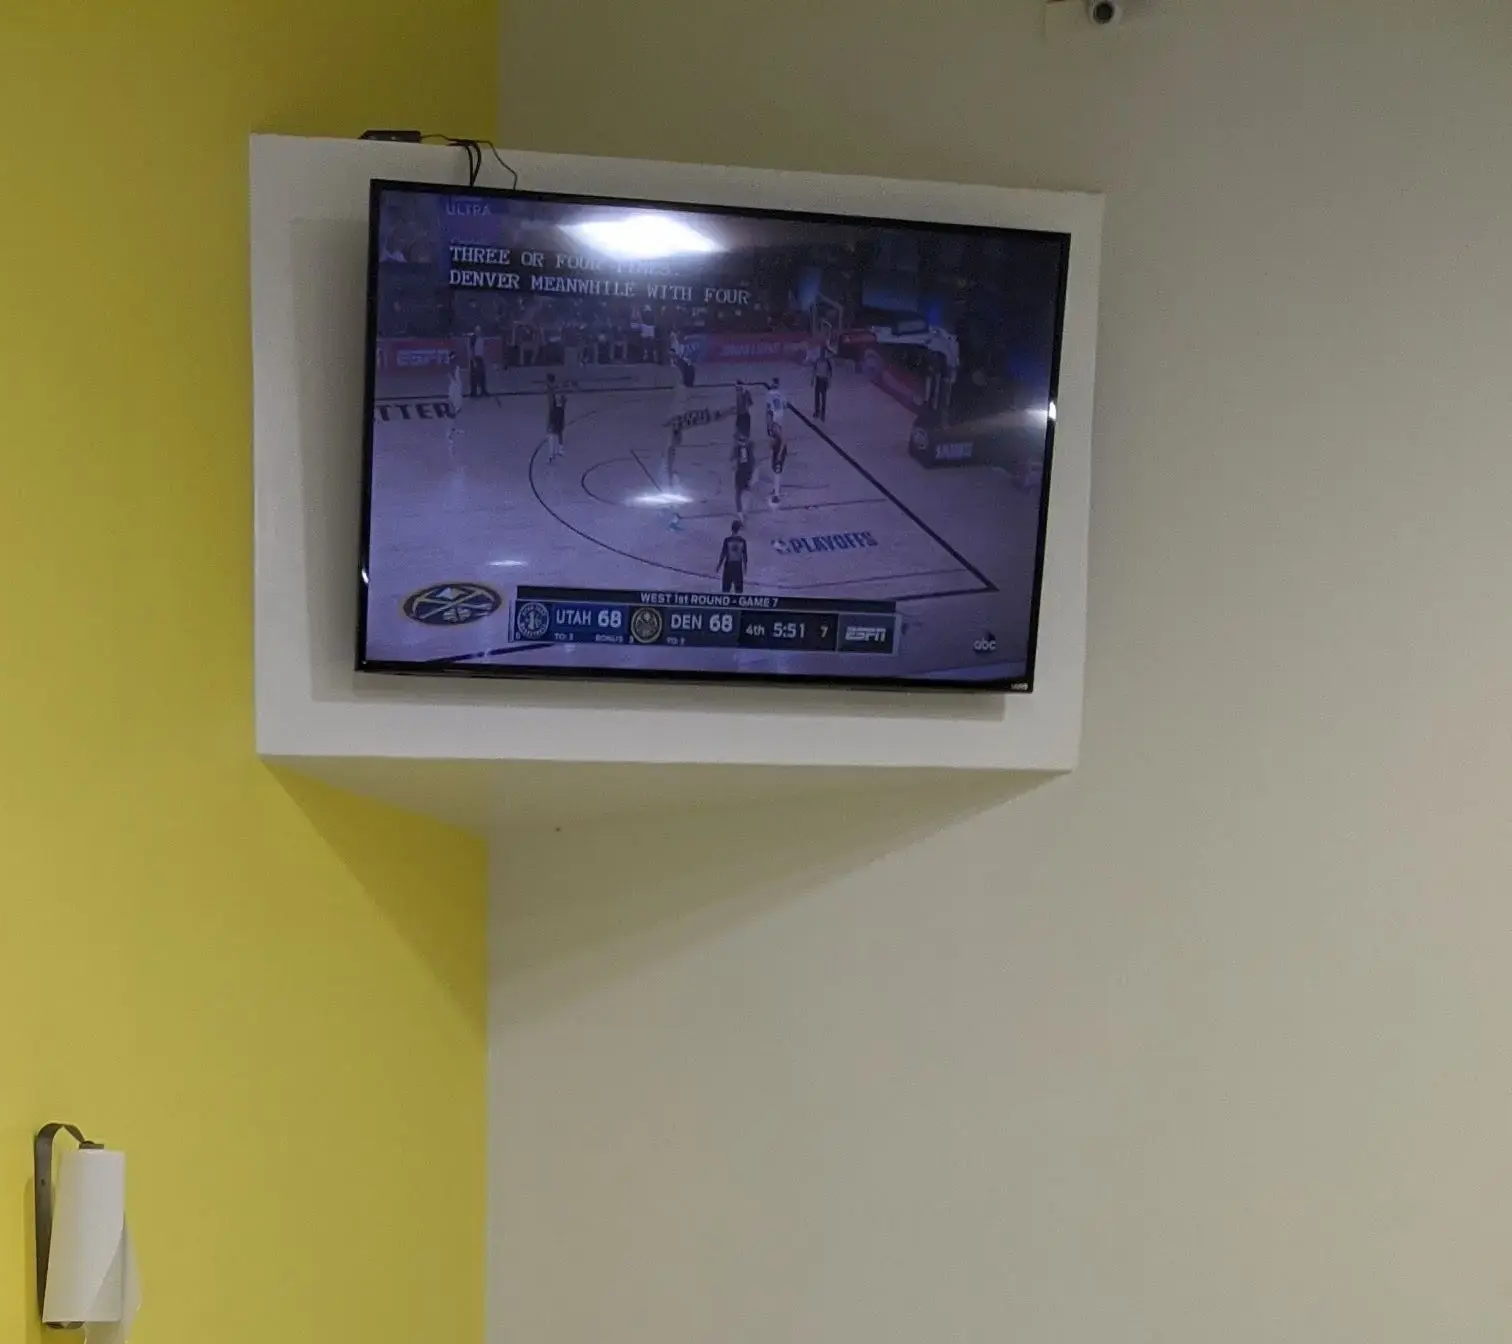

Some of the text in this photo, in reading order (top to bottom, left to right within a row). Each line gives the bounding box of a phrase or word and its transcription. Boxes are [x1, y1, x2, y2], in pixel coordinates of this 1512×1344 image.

[446, 203, 492, 216] ULTRA
[449, 246, 510, 265] THREE
[521, 251, 544, 267] OR
[556, 254, 602, 271] FOUR
[449, 270, 750, 305] DENVER MEANWHILE WITH FOUR
[789, 531, 878, 553] PLAYOFFS
[640, 592, 671, 604] WEST
[691, 594, 730, 606] ROUND
[738, 596, 769, 607] GAME
[556, 609, 591, 626] UTAH
[597, 610, 622, 628] 68
[670, 614, 733, 632] DEN 68
[745, 622, 829, 638] 4th 5:51 7
[844, 626, 886, 642] ESPN
[974, 636, 996, 650] abc
